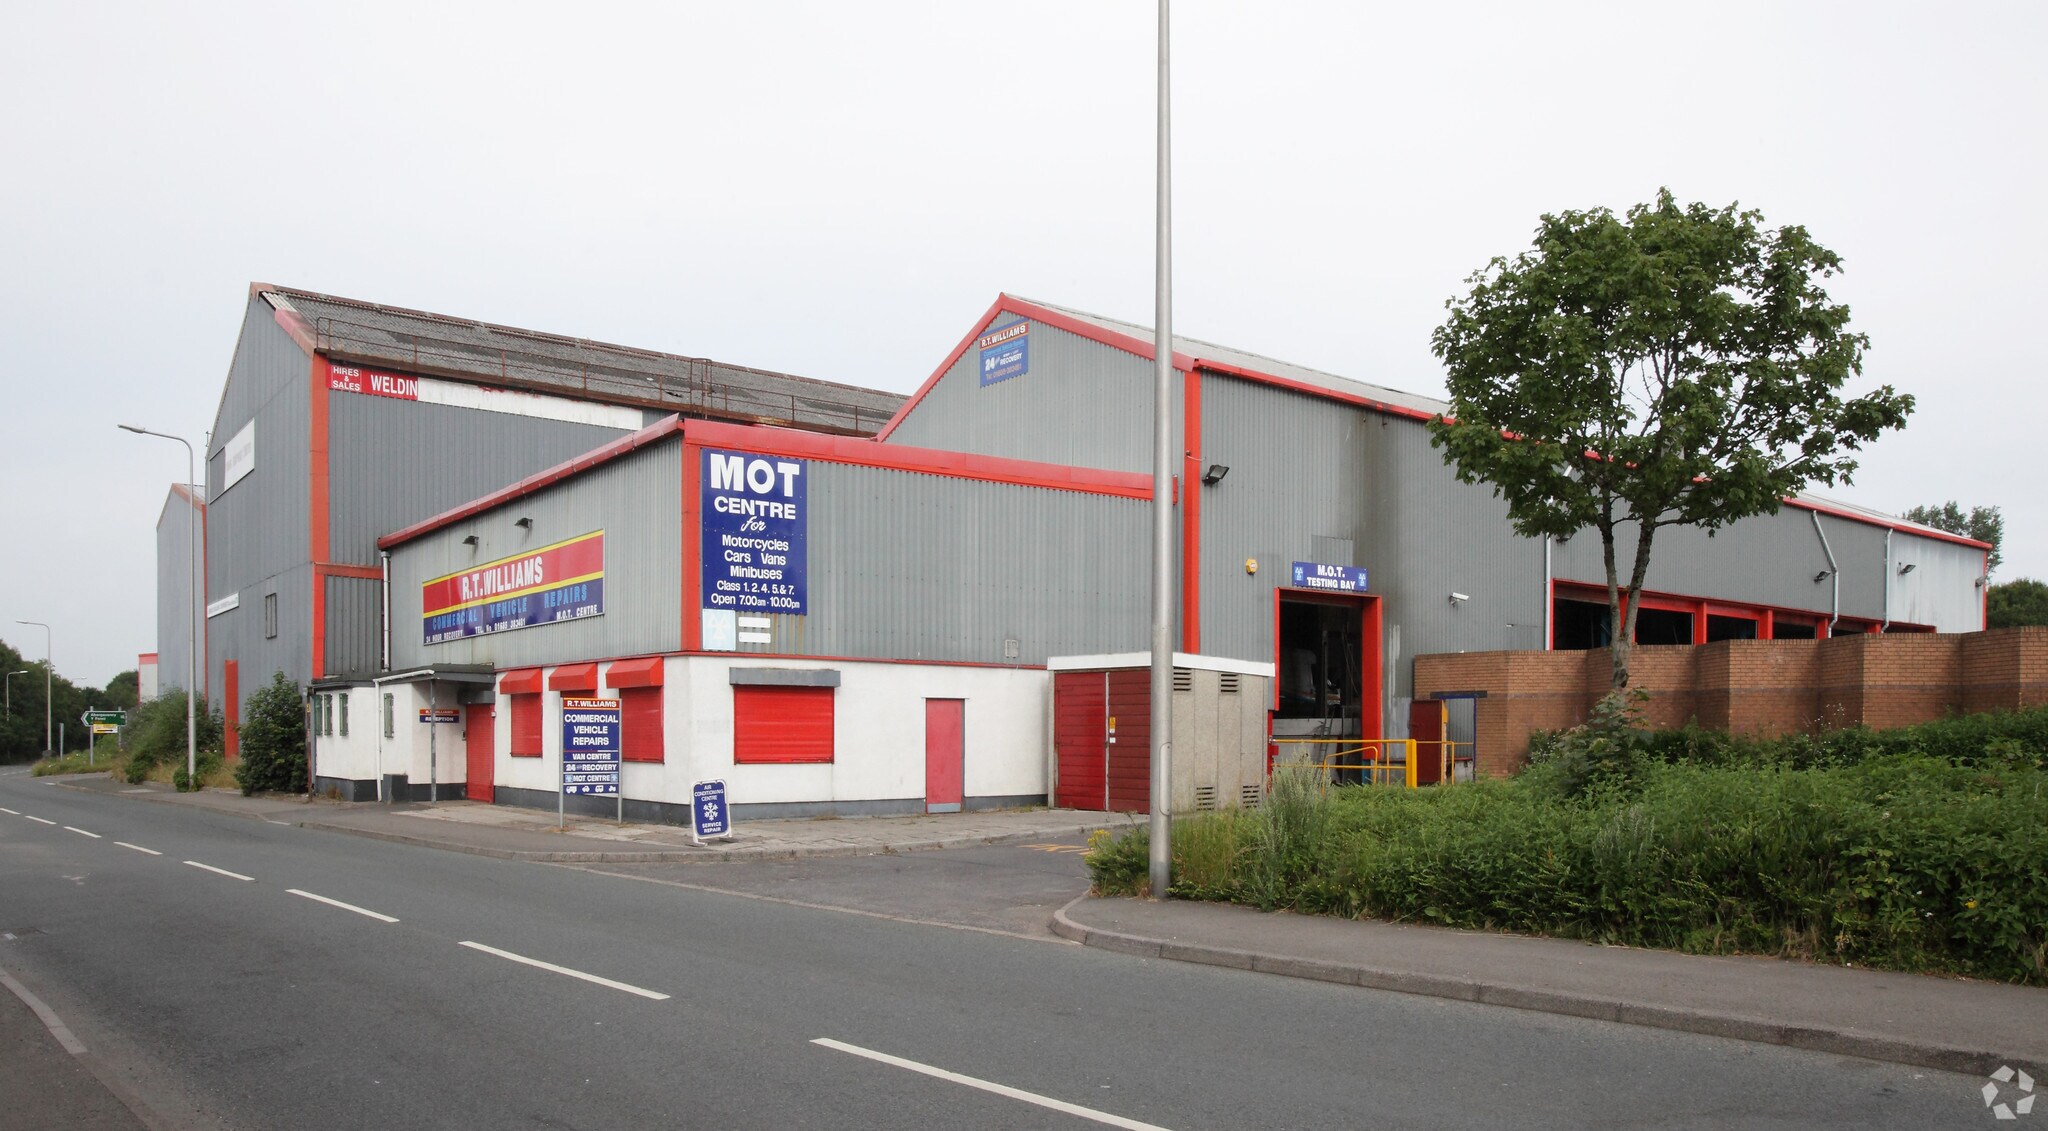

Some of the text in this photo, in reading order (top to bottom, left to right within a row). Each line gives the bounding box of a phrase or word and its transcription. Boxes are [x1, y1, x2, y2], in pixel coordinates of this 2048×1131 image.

[333, 366, 360, 377] HIRES
[985, 357, 995, 372] 24
[332, 380, 360, 391] SALES
[370, 374, 418, 396] WELDIN
[710, 453, 800, 497] MOT
[714, 496, 796, 520] CENTRE
[740, 516, 766, 532] for
[722, 534, 789, 551] Motorcycles
[724, 550, 786, 566] Cars Vans
[730, 565, 782, 580] Minibuses
[1318, 564, 1345, 578] M.O.T.
[716, 580, 740, 592] Class
[1307, 577, 1356, 590] TESTING BAY
[711, 593, 736, 605] Open
[432, 584, 588, 630] COMMERCIAL VEHICLE REPAIRS
[576, 604, 597, 617] CENTRE
[564, 714, 618, 723] COMMERCIAL
[574, 726, 608, 734] VEHICLE
[573, 737, 609, 746] REPAIRS
